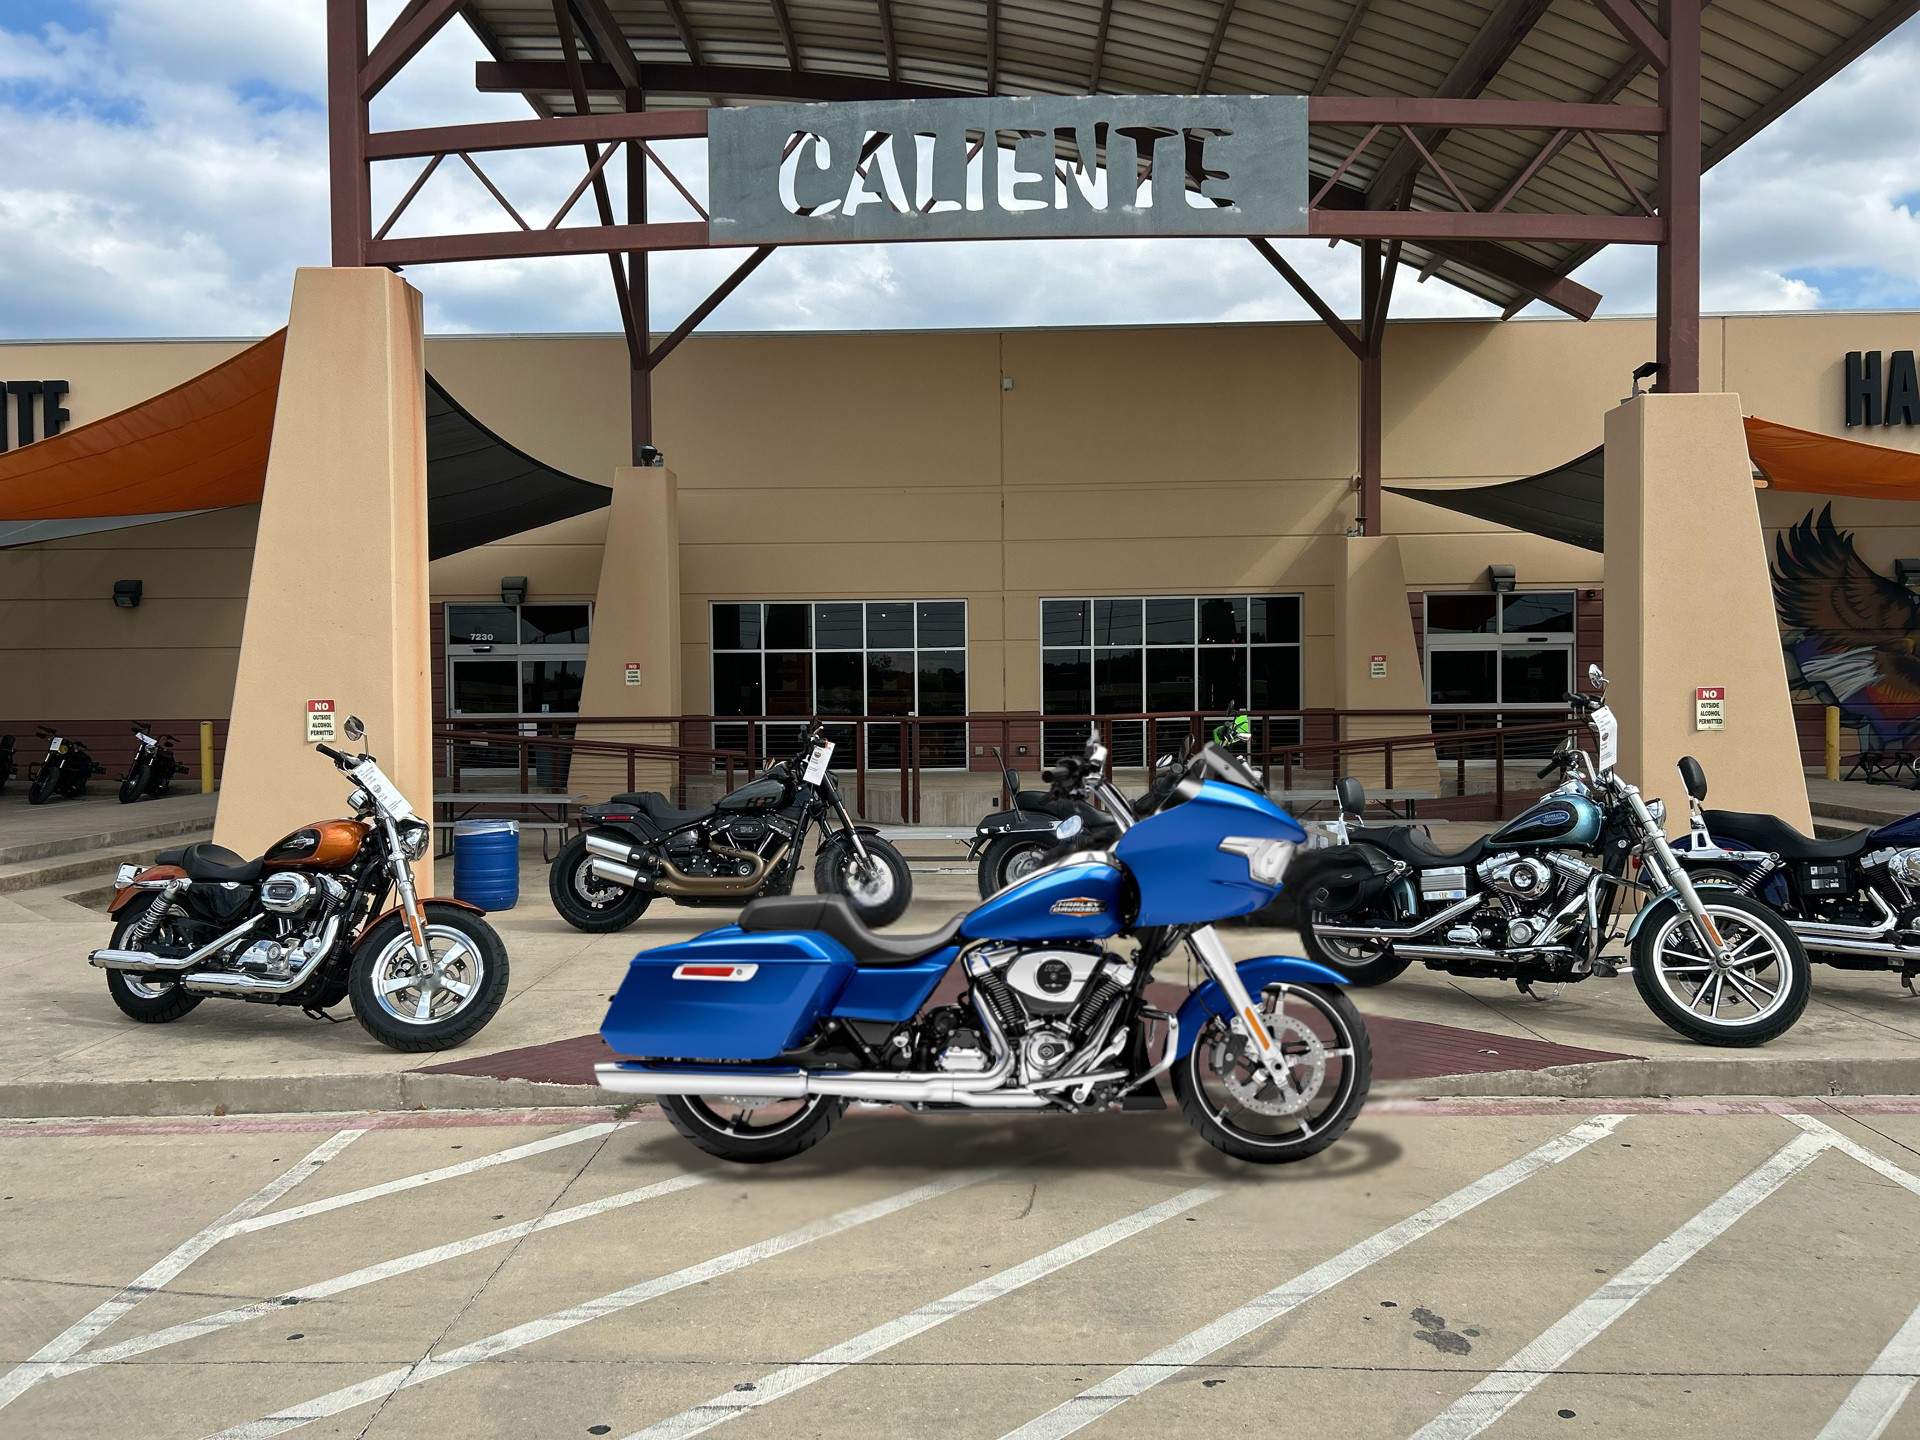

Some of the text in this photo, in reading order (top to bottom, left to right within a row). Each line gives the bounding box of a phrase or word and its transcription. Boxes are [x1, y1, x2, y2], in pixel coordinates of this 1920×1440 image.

[779, 122, 1235, 217] CALIENTE
[470, 633, 494, 641] 7230
[1702, 690, 1718, 699] NO
[314, 702, 329, 711] NO
